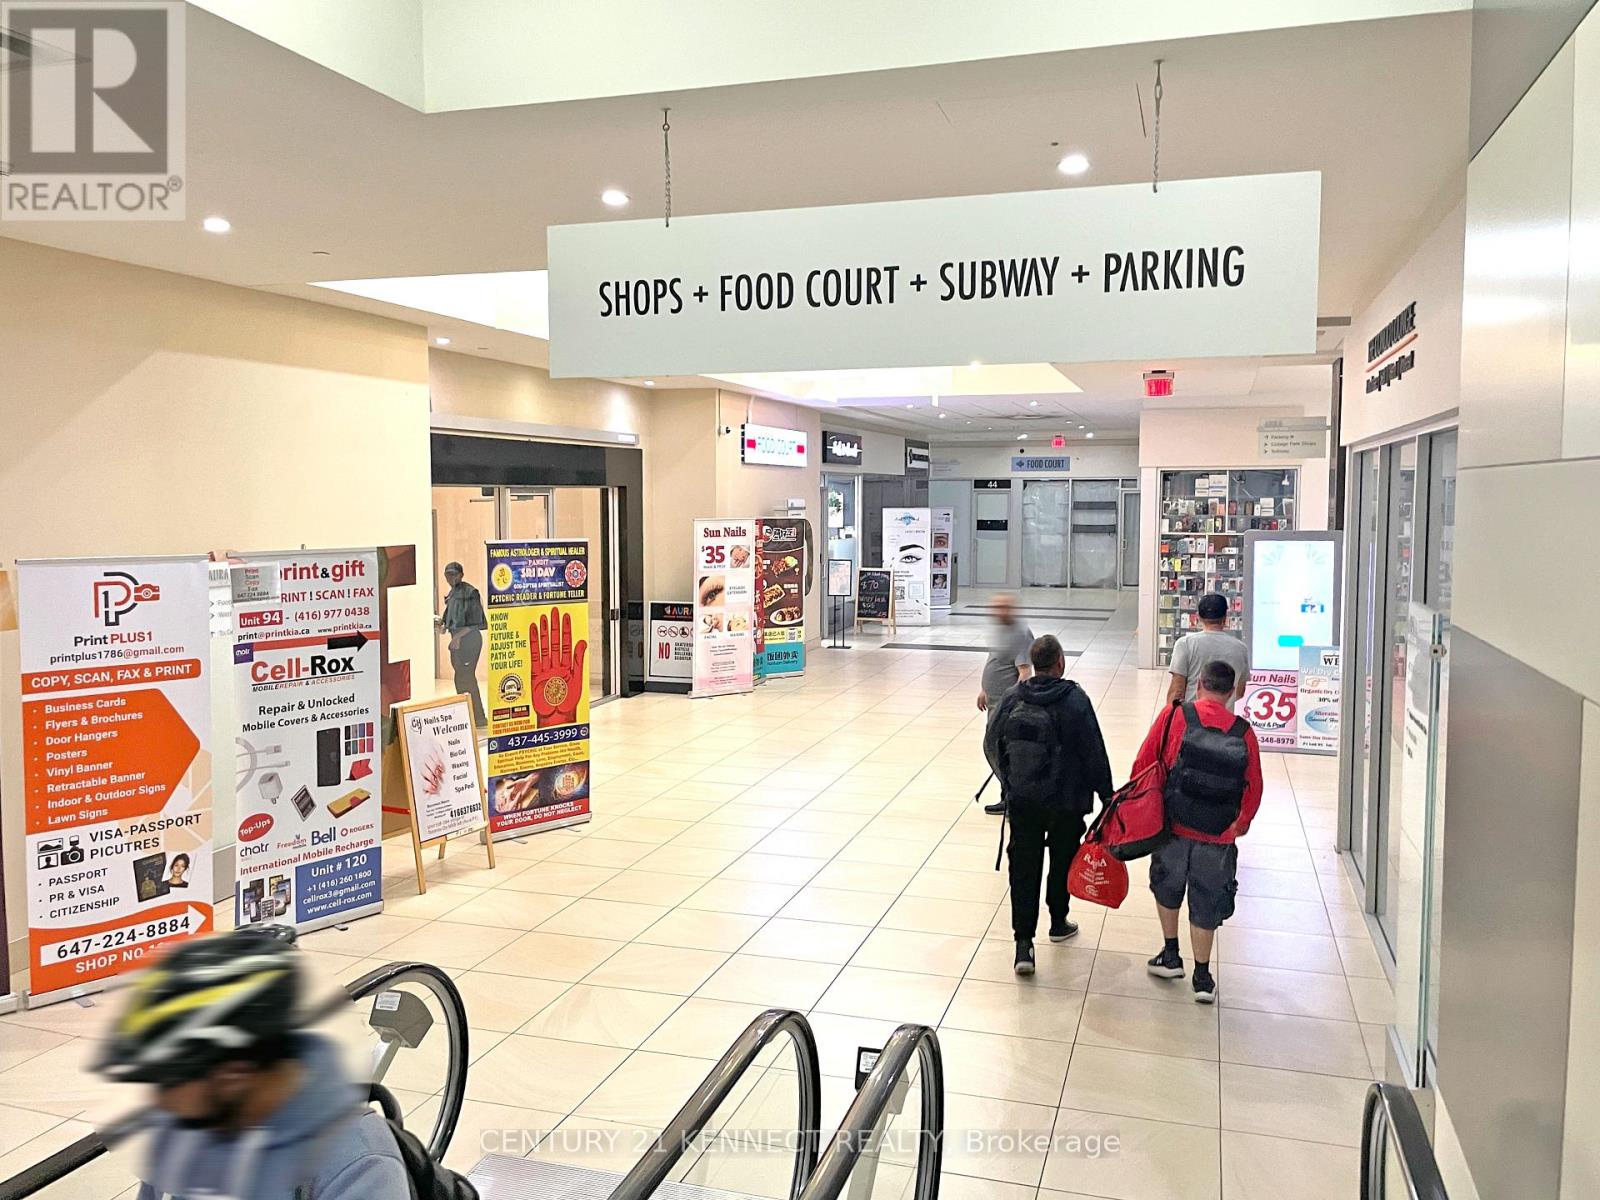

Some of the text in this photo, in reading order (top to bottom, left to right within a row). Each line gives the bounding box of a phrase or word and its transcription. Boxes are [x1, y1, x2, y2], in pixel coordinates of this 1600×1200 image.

[598, 245, 1245, 317] SHOPS + FOOD COURT + SUBWAY + PARKING
[1026, 459, 1064, 469] FOOD COURT
[704, 526, 746, 538] Sun Nails
[490, 548, 510, 558] FAMOUS
[510, 548, 540, 556] ASTROLOGER
[544, 547, 568, 556] SPIRITUAL
[568, 546, 585, 556] HEALER
[281, 592, 308, 603] RINT
[316, 590, 345, 602] SCAN
[353, 588, 374, 598] FAX
[492, 594, 514, 603] PSYCHIC
[516, 593, 538, 601] READER
[544, 591, 567, 600] FORTUNE
[568, 590, 584, 598] TELLER
[240, 606, 370, 627] Unit 94 (416) 977 0438
[490, 612, 508, 621] KNOW
[238, 626, 310, 642] print@printkia.ca
[490, 622, 508, 631] YOUR
[74, 631, 152, 647] Print PLUS1
[490, 632, 514, 641] FUTURE
[490, 640, 526, 650] ADJUST THE
[50, 645, 184, 665] printplus1786@gmail.com
[490, 650, 516, 661] PATH OF
[658, 642, 670, 660] NO
[251, 656, 354, 683] Cell-Rox
[490, 660, 522, 670] YOUR LIFE!
[32, 664, 192, 688] COPY, SCAN, FAX & PRINT
[1269, 674, 1296, 684] Nails
[45, 698, 126, 714] Business Cards
[258, 692, 355, 716] Repair & Unlocked
[45, 710, 144, 732] Flyers & Brochures
[242, 706, 369, 732] Mobile Covers & Accessories
[424, 714, 452, 726] Nails Spa
[46, 729, 118, 746] Door Hangers
[432, 722, 469, 737] Welcome
[508, 728, 578, 747] 437-445-3999
[46, 749, 88, 762] Posters
[46, 760, 113, 778] Vinyl Banner
[452, 772, 468, 781] Facial
[46, 772, 146, 793] Retractable Banner
[48, 783, 166, 809] Indoor & Outdoor Signs
[48, 808, 108, 825] Lawn Signs
[504, 802, 574, 820] WHEN FORTUNE KNOCKS
[534, 812, 544, 820] DO
[544, 810, 556, 818] NOT
[556, 805, 582, 816] NEGLECT
[89, 813, 202, 842] VISA-PASSPORT
[240, 818, 271, 836] Top-Ups
[311, 826, 336, 846] Bell
[349, 823, 374, 834] ROGERS
[90, 838, 160, 860] PICUTRES
[240, 842, 270, 858] chatr
[240, 838, 374, 876] International Mobile Recharge
[311, 854, 368, 878] Unit # 120
[48, 868, 108, 886] PASSPORT
[306, 882, 317, 892] +1
[339, 874, 352, 885] 260
[354, 870, 372, 880] 1800
[49, 884, 105, 903] PR & VISA
[303, 879, 376, 906] cellrox3@gmail.com
[49, 896, 120, 918] CITIZENSHIP
[307, 892, 372, 914] www.cell-rox.com
[57, 916, 190, 960] 647-224-8884
[75, 954, 118, 974] SHOP
